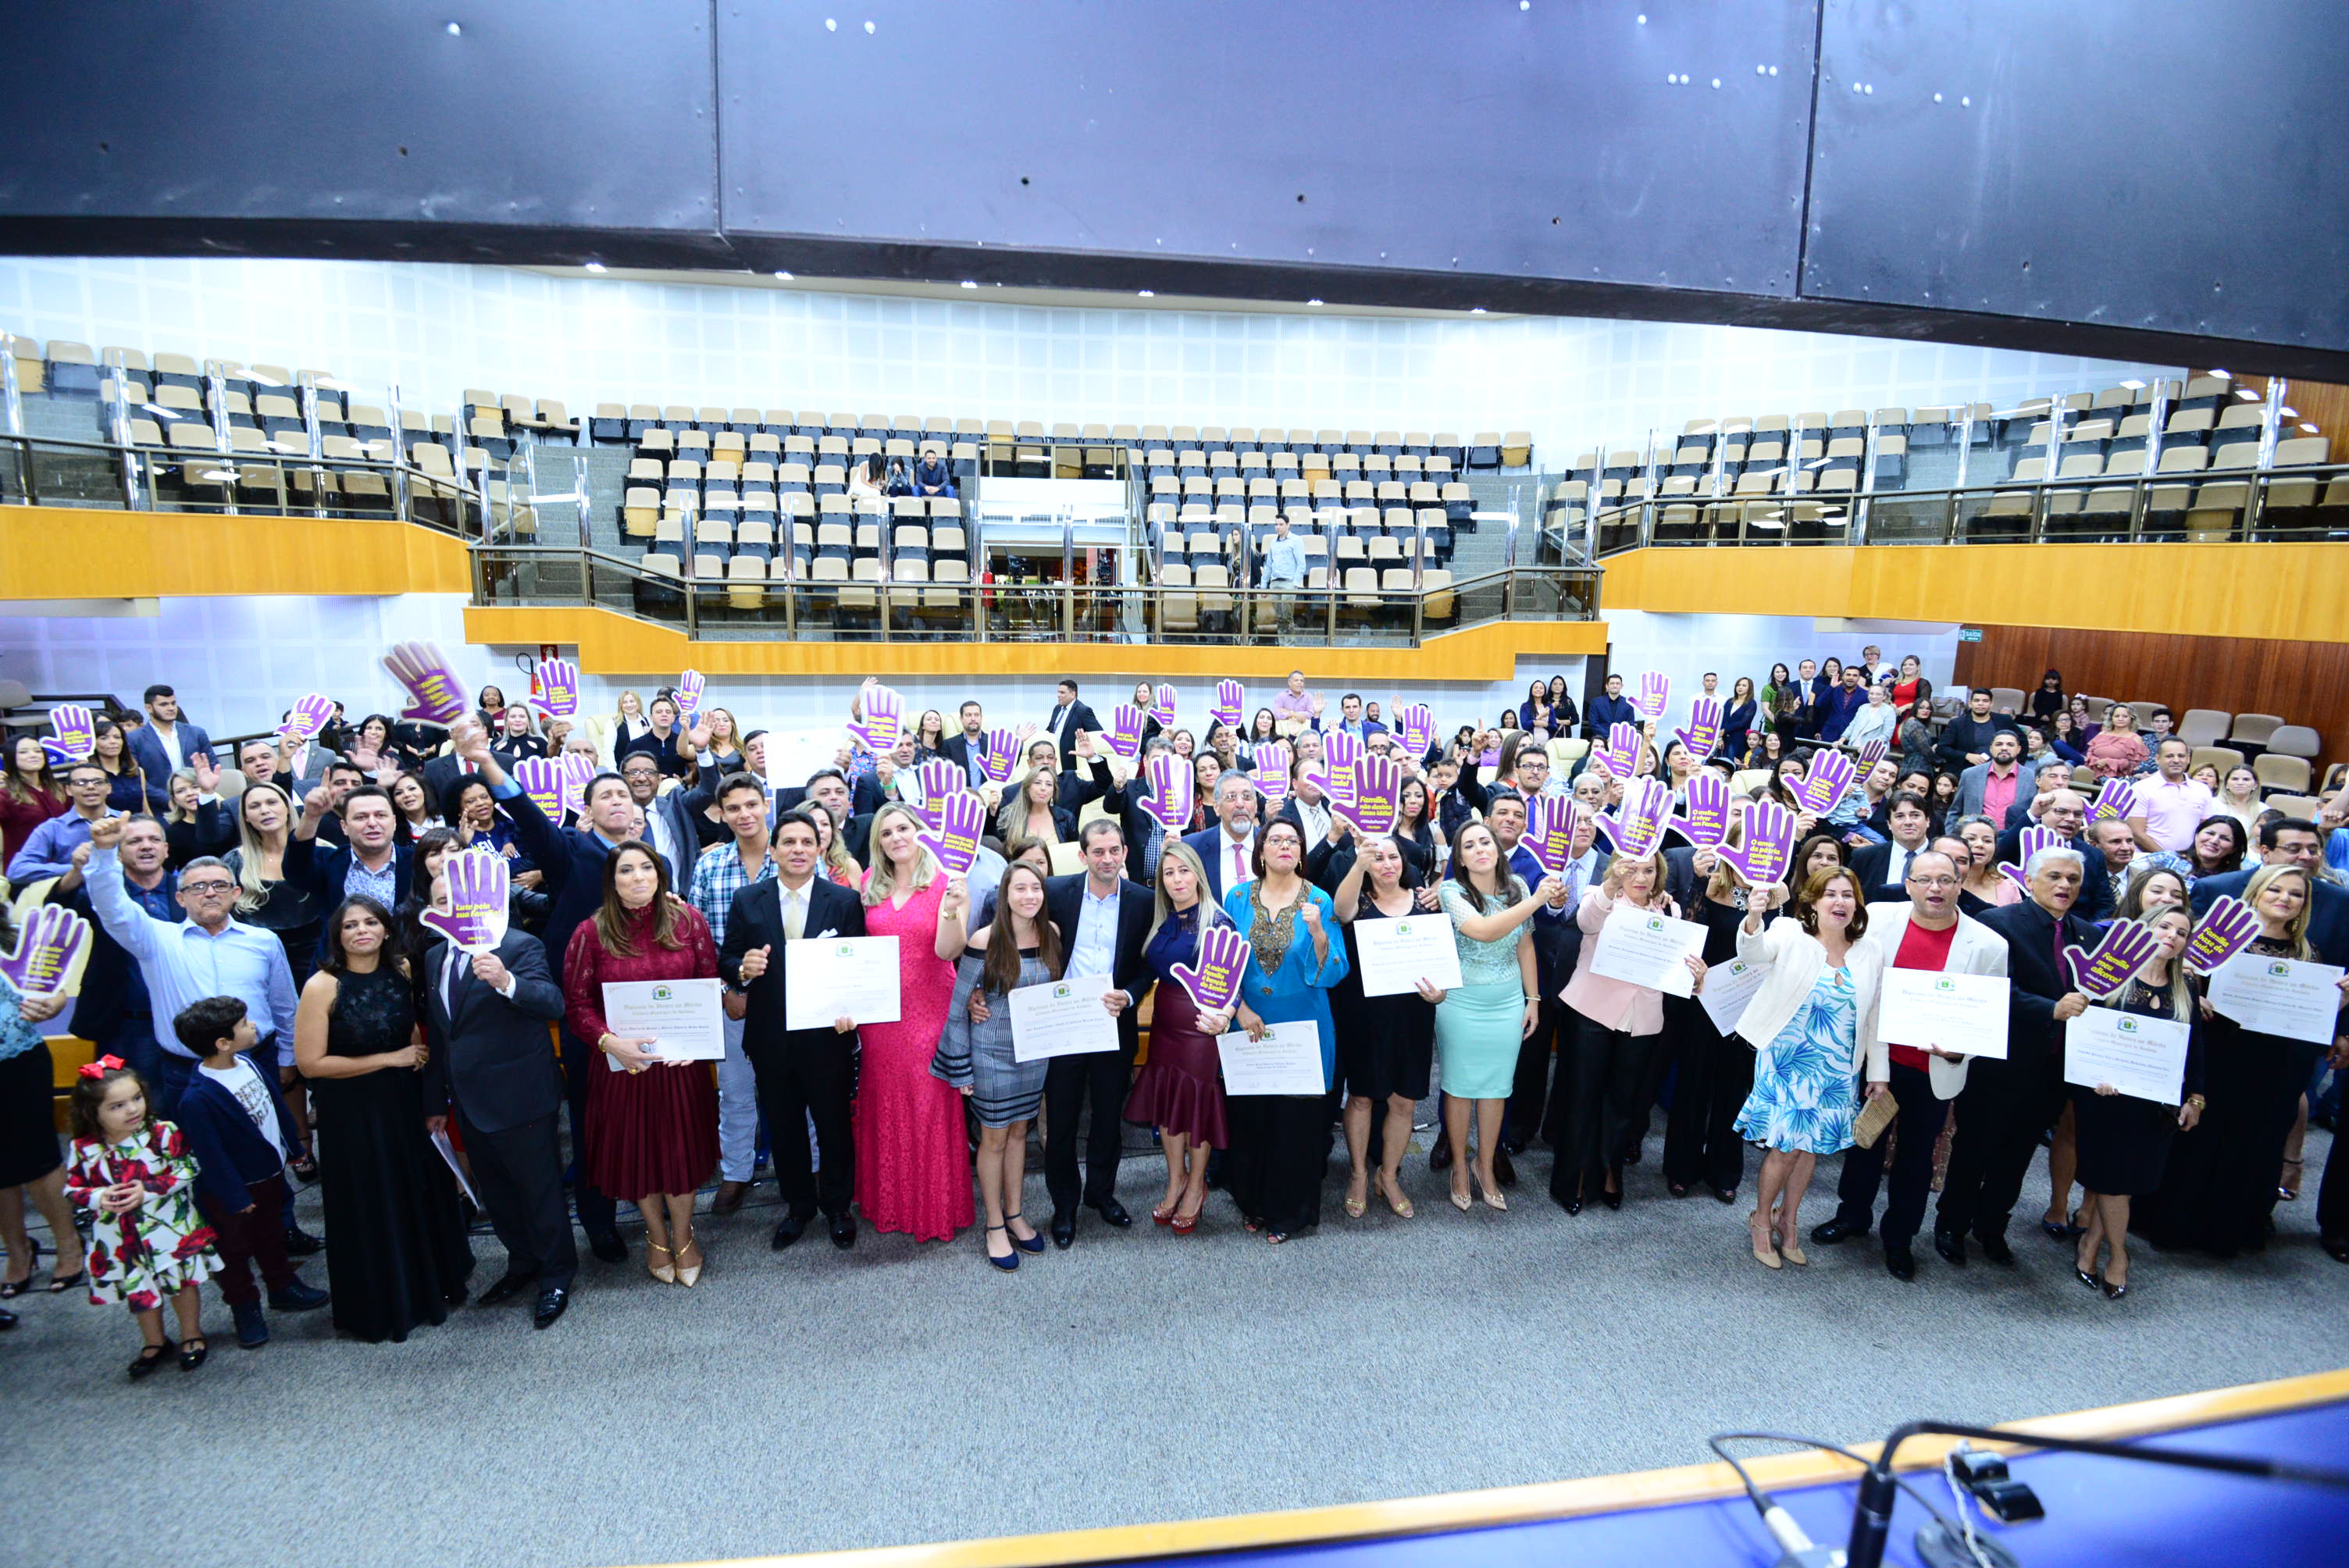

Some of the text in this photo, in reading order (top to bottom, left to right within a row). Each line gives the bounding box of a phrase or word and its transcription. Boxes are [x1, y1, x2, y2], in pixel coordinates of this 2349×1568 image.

[2198, 932, 2225, 954] base de
[2203, 927, 2230, 947] Família
[2192, 939, 2214, 955] tudo!
[2096, 960, 2114, 971] meu
[2101, 952, 2130, 970] Família
[1203, 969, 1225, 980] Família
[1210, 965, 1230, 975] minha
[2090, 966, 2123, 984] alicerce!
[1208, 984, 1229, 994] Senhor
